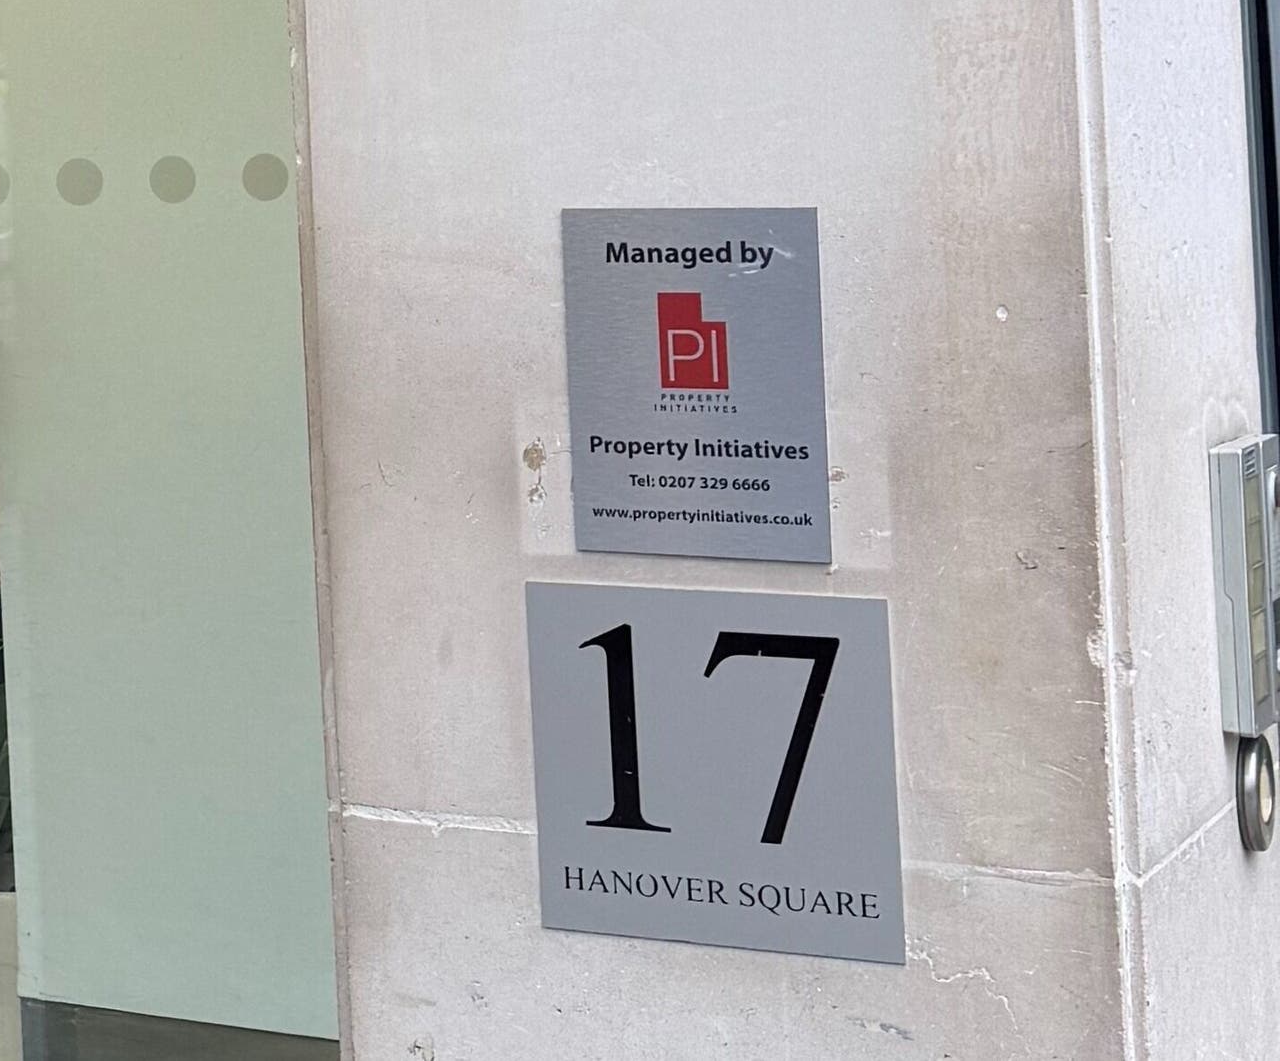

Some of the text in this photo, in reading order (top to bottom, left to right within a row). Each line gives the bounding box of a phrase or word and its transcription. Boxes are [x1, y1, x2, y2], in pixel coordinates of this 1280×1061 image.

[605, 240, 774, 269] Managed by
[667, 329, 719, 382] PI
[654, 404, 737, 413] INITIATIVES
[661, 393, 730, 402] PROPERTY
[590, 436, 809, 461] Property Initiatives
[629, 474, 771, 492] Tel: 0207 329 6666
[592, 506, 813, 526] www.propertyinitiatives.co.uk
[578, 623, 840, 845] 17
[564, 866, 881, 919] HANOVER SQUARE
